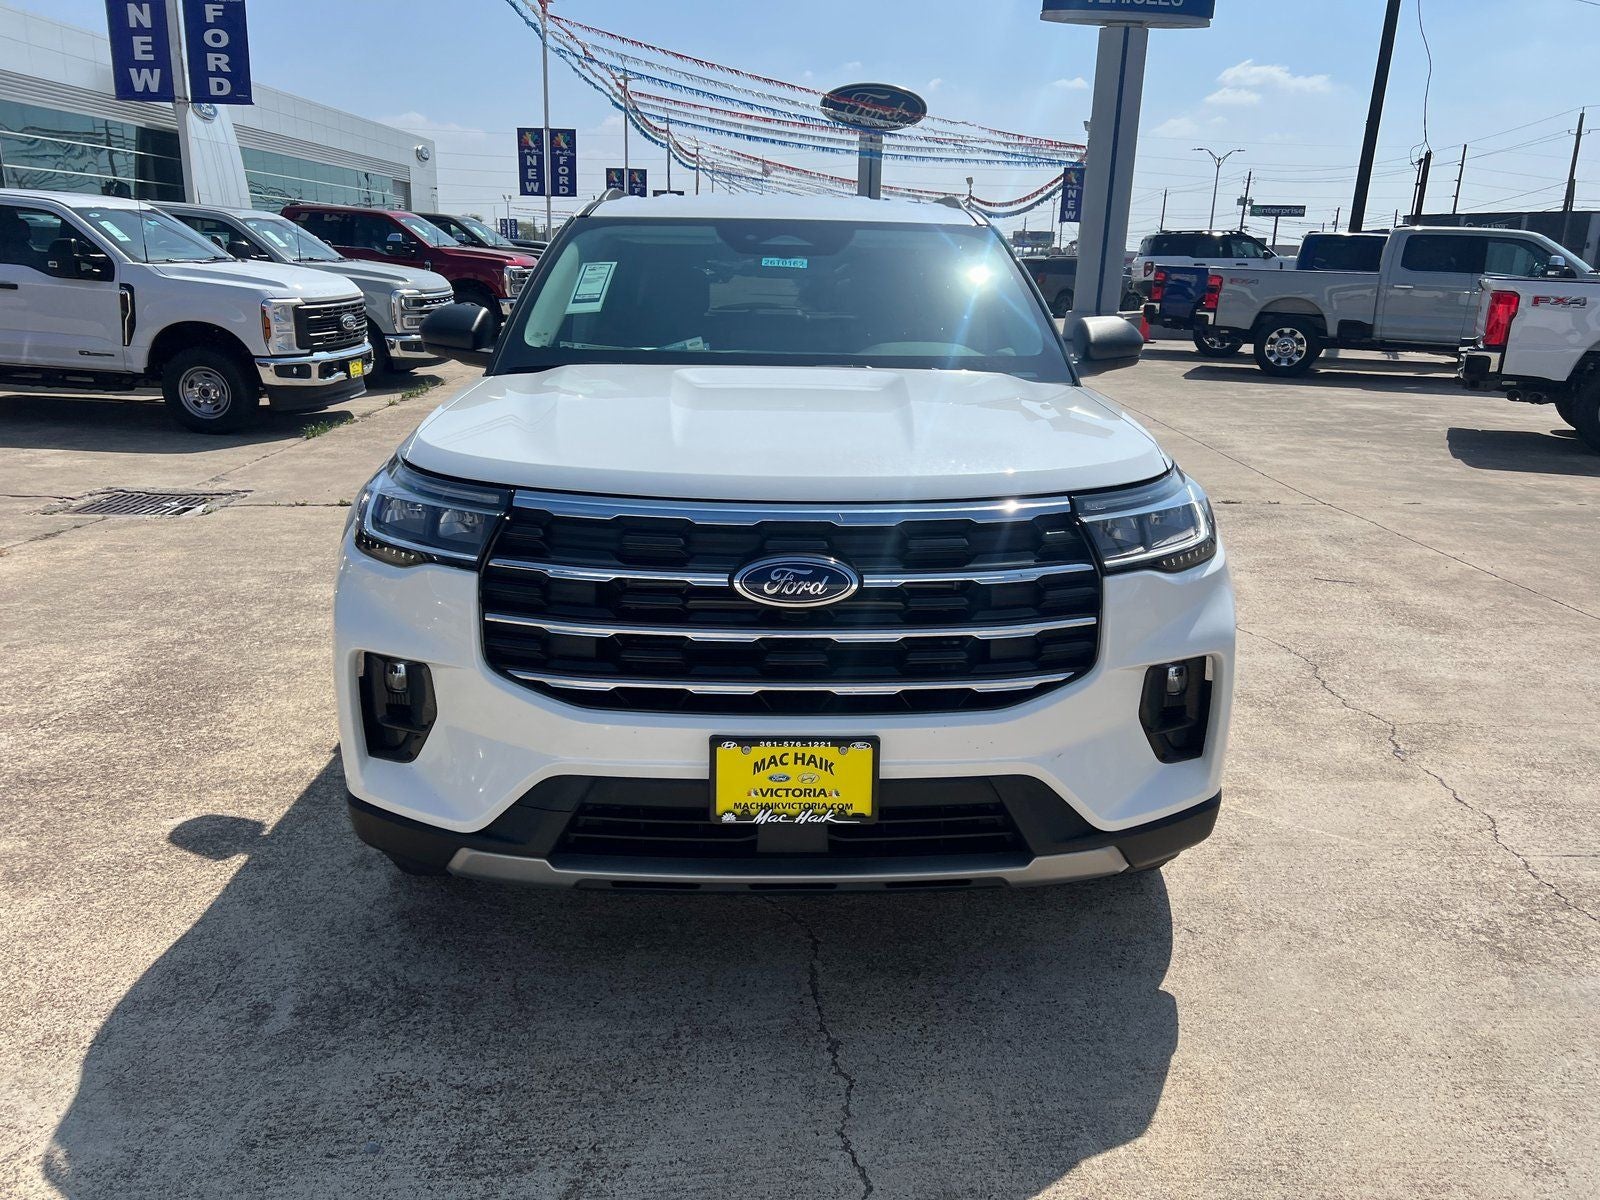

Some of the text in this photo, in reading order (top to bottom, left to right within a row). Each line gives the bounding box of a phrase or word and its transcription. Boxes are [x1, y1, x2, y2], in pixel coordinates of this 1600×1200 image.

[126, 3, 161, 93] NEW
[203, 4, 232, 96] FORD
[525, 155, 539, 193] NEW
[558, 156, 569, 194] FORD
[1064, 190, 1077, 219] NEW
[1532, 296, 1587, 306] FX4
[763, 567, 830, 595] Ford
[753, 752, 835, 776] MAC HAIK
[733, 802, 853, 810] MACHAIKVICTORIA.COM
[759, 788, 828, 798] VICTORIA
[752, 808, 837, 825] Mac Haik
